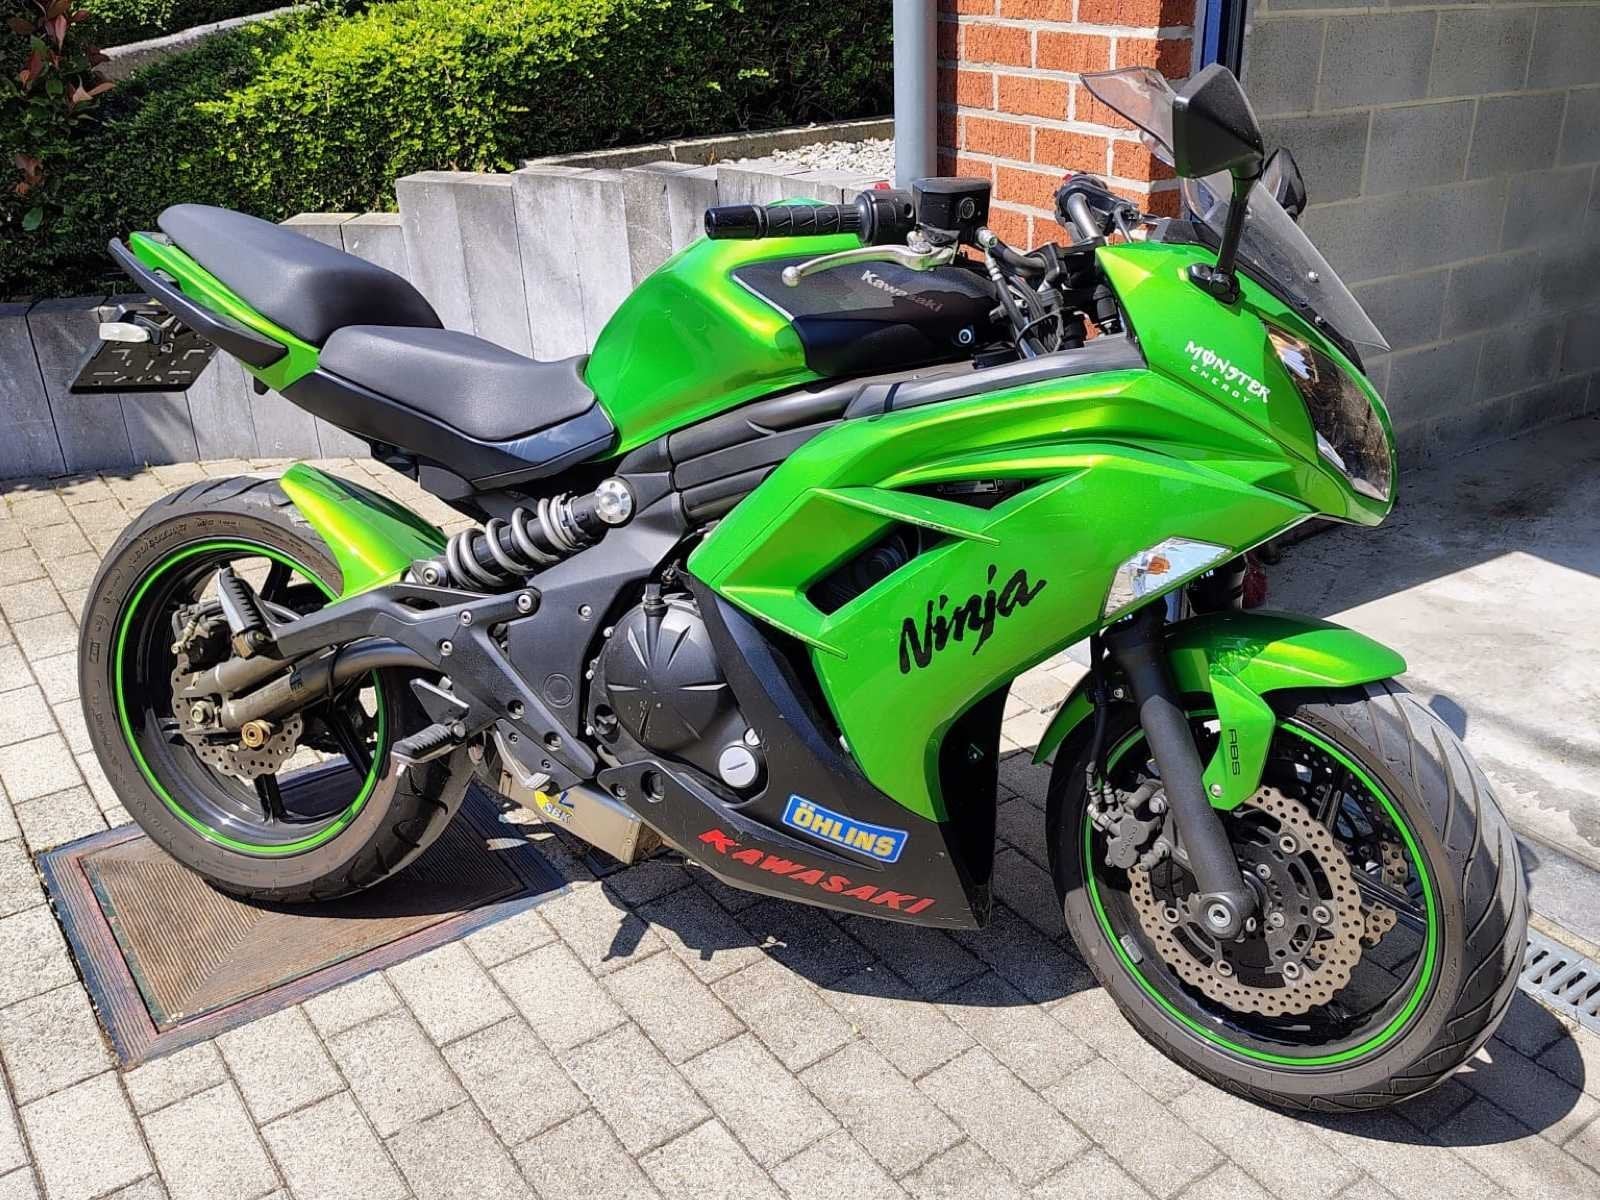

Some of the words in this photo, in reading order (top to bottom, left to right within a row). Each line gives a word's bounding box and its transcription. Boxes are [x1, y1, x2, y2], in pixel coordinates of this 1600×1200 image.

[861, 270, 944, 313] Kawasaki
[1190, 364, 1250, 403] ENERGY
[899, 564, 1047, 674] Ninja
[1228, 728, 1241, 776] ABS
[793, 802, 896, 856] ÖHLINS
[698, 829, 936, 914] KAWASAKI
